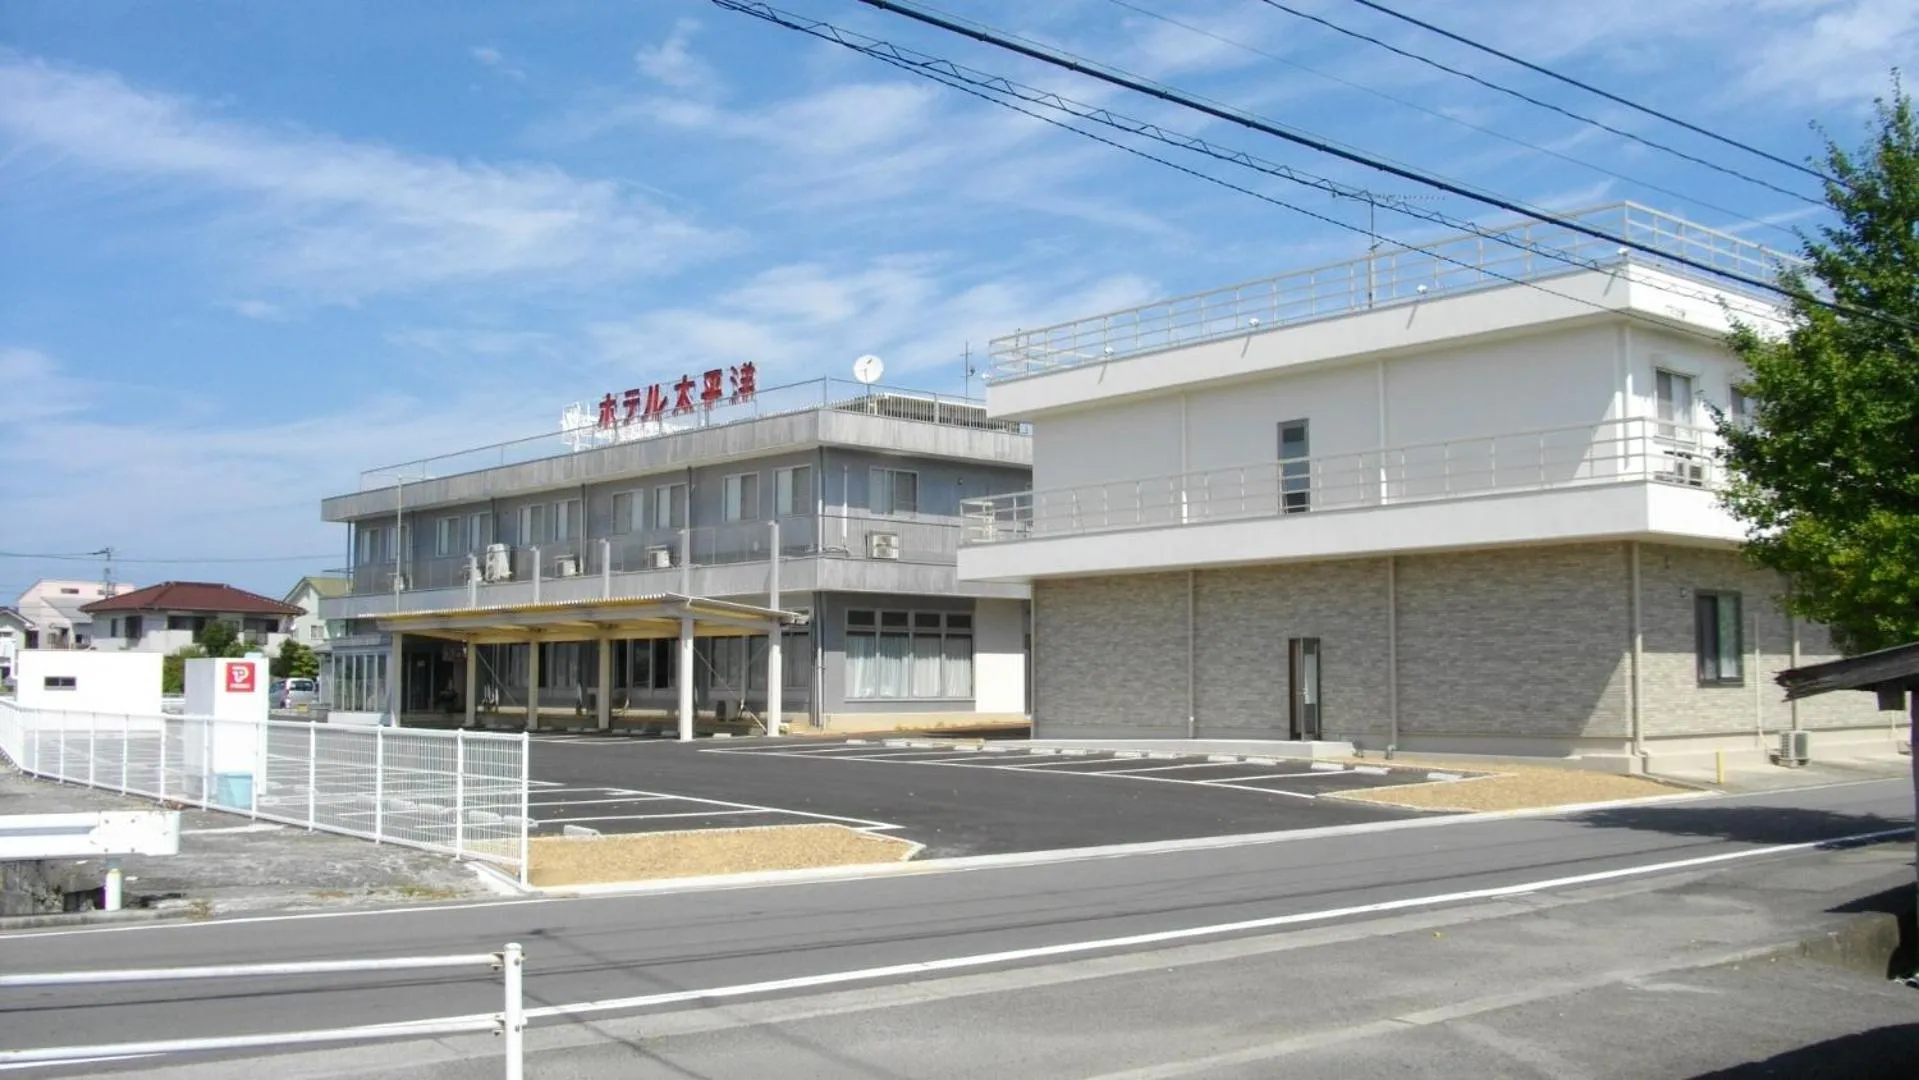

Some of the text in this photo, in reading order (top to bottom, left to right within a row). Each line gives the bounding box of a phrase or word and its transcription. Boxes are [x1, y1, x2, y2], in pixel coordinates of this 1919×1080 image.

[598, 361, 756, 430] ホテル太平洋
